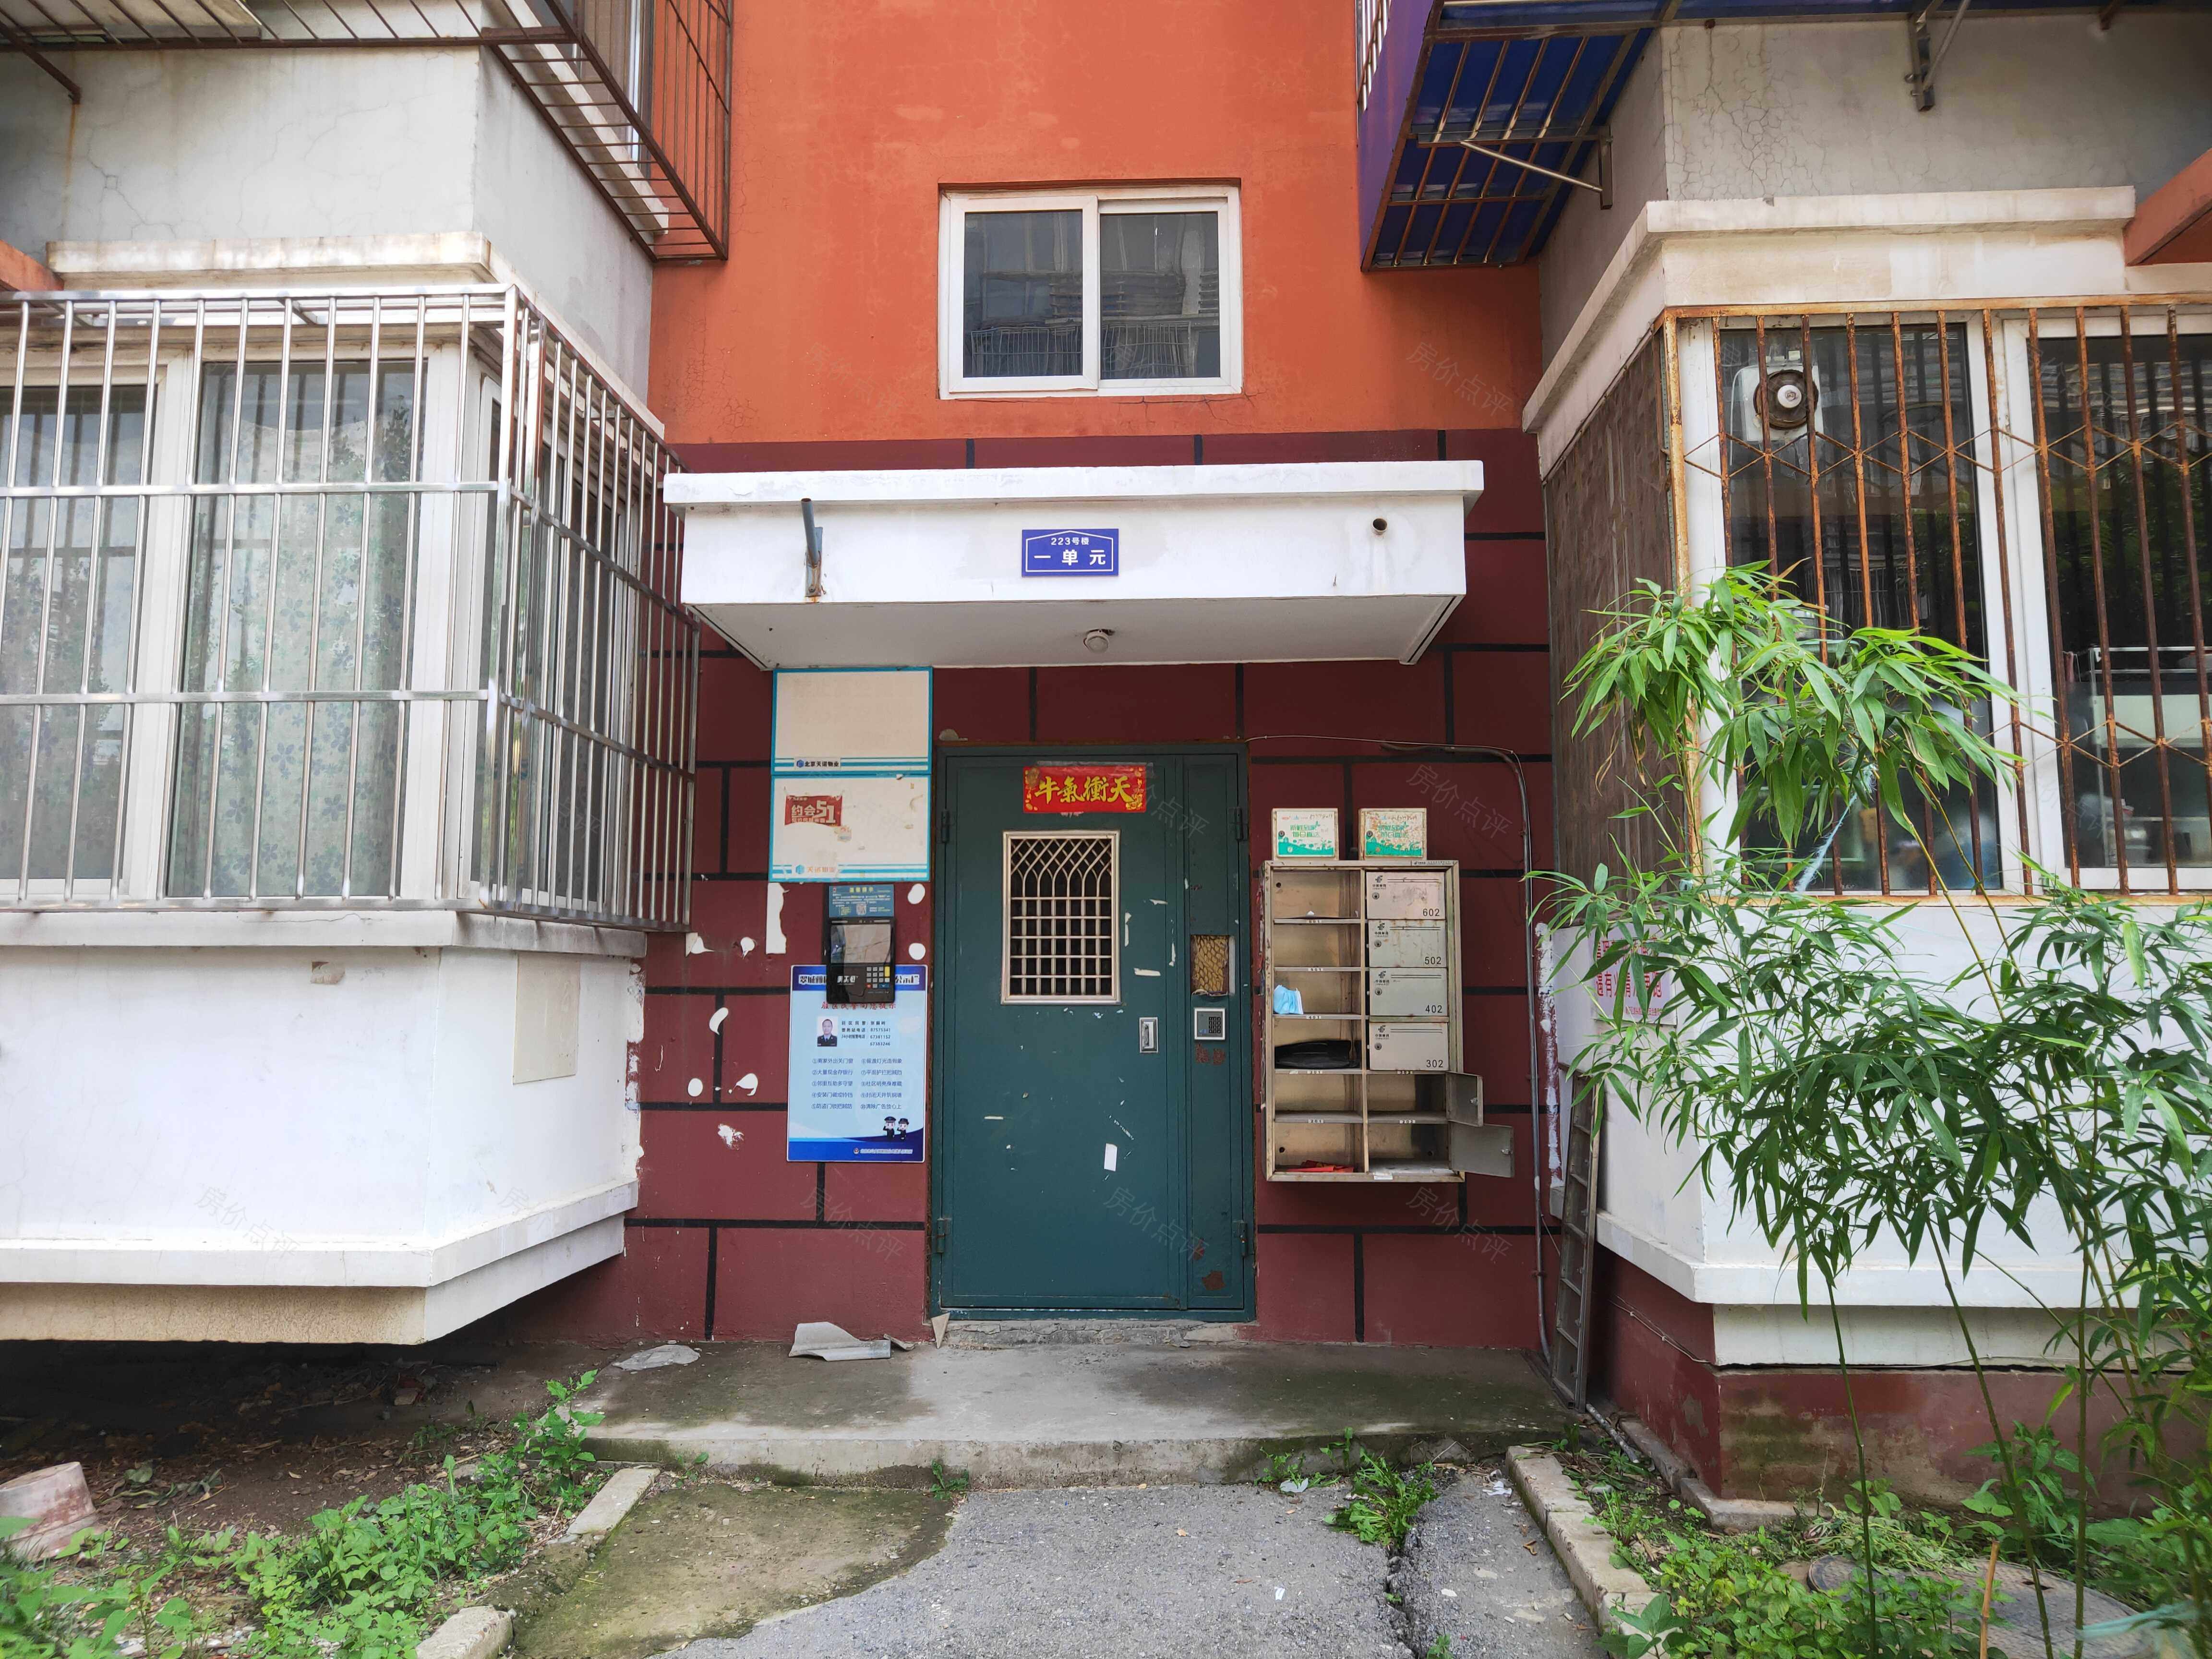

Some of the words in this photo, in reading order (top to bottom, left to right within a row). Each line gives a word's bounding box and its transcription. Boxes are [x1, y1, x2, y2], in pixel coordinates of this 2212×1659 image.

[1051, 537, 1090, 545] 223号楼
[1034, 549, 1106, 565] 一单元
[1034, 776, 1134, 803] 牛氣衝天
[1425, 1005, 1443, 1013] 402
[1426, 1059, 1443, 1068] 302
